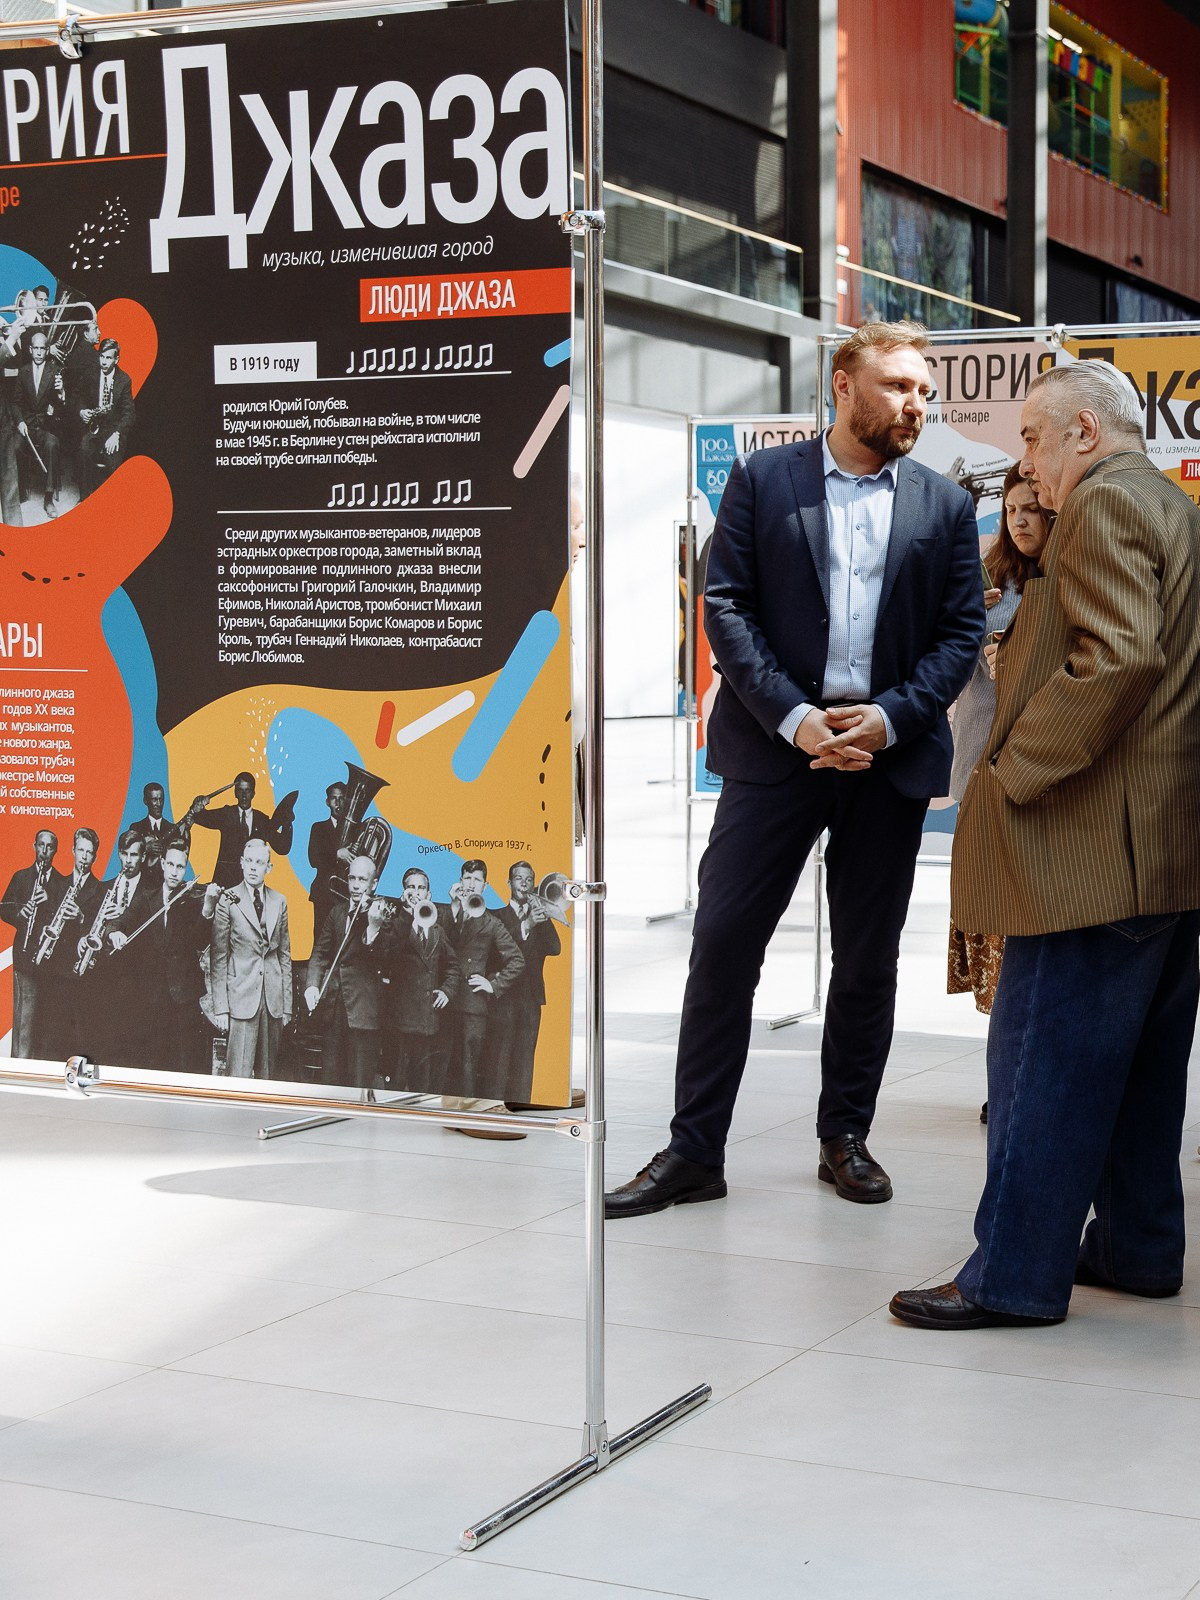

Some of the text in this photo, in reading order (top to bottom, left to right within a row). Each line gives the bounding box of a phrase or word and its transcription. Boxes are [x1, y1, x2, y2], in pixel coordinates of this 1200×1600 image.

[2, 43, 569, 273] РИЯ Джаза
[262, 236, 494, 271] музыка, изменившая город
[368, 278, 517, 317] ЛЮДИ ДЖАЗА
[230, 356, 300, 373] В 1919 году
[223, 397, 349, 416] родился Юрий Голубев.
[223, 413, 481, 434] Будучи юношей, побывал на войне, в том числе
[925, 409, 990, 426] ии и Самаре
[215, 431, 481, 450] в мае 1945 г. в Берлине у стен рейхстага исполнил
[216, 450, 378, 469] на своей трубе сигнал победы.
[225, 527, 481, 543] Среди других музыкантов-ветеранов, лидеров
[217, 543, 482, 560] эстрадных оркестров города, заметный вклад
[217, 562, 482, 578] в формирование подлинного джаза внесли
[217, 579, 482, 596] саксофонисты Григорий Галочкин, Владимир
[217, 597, 482, 614] Ефимов, Николай Аристов, тромбонист Михаил
[218, 615, 483, 633] Гуревич, барабанщики Борис Комаров и Борис
[218, 632, 483, 651] Кроль, трубач Геннадий Николаев, контрабасист
[218, 649, 305, 666] Борис Любимов.
[42, 689, 75, 701] джаза
[2, 705, 33, 717] годов
[51, 706, 75, 716] века
[11, 722, 75, 735] музыкантов,
[3, 738, 38, 748] нового
[38, 739, 73, 753] жанра.
[0, 754, 75, 769] зовался трубач
[0, 770, 75, 785] кестре Моисея
[9, 786, 75, 800] собственные
[10, 805, 75, 820] кинотеатрах,
[417, 838, 532, 856] Оркестр В. Спориуса 1937 г.
